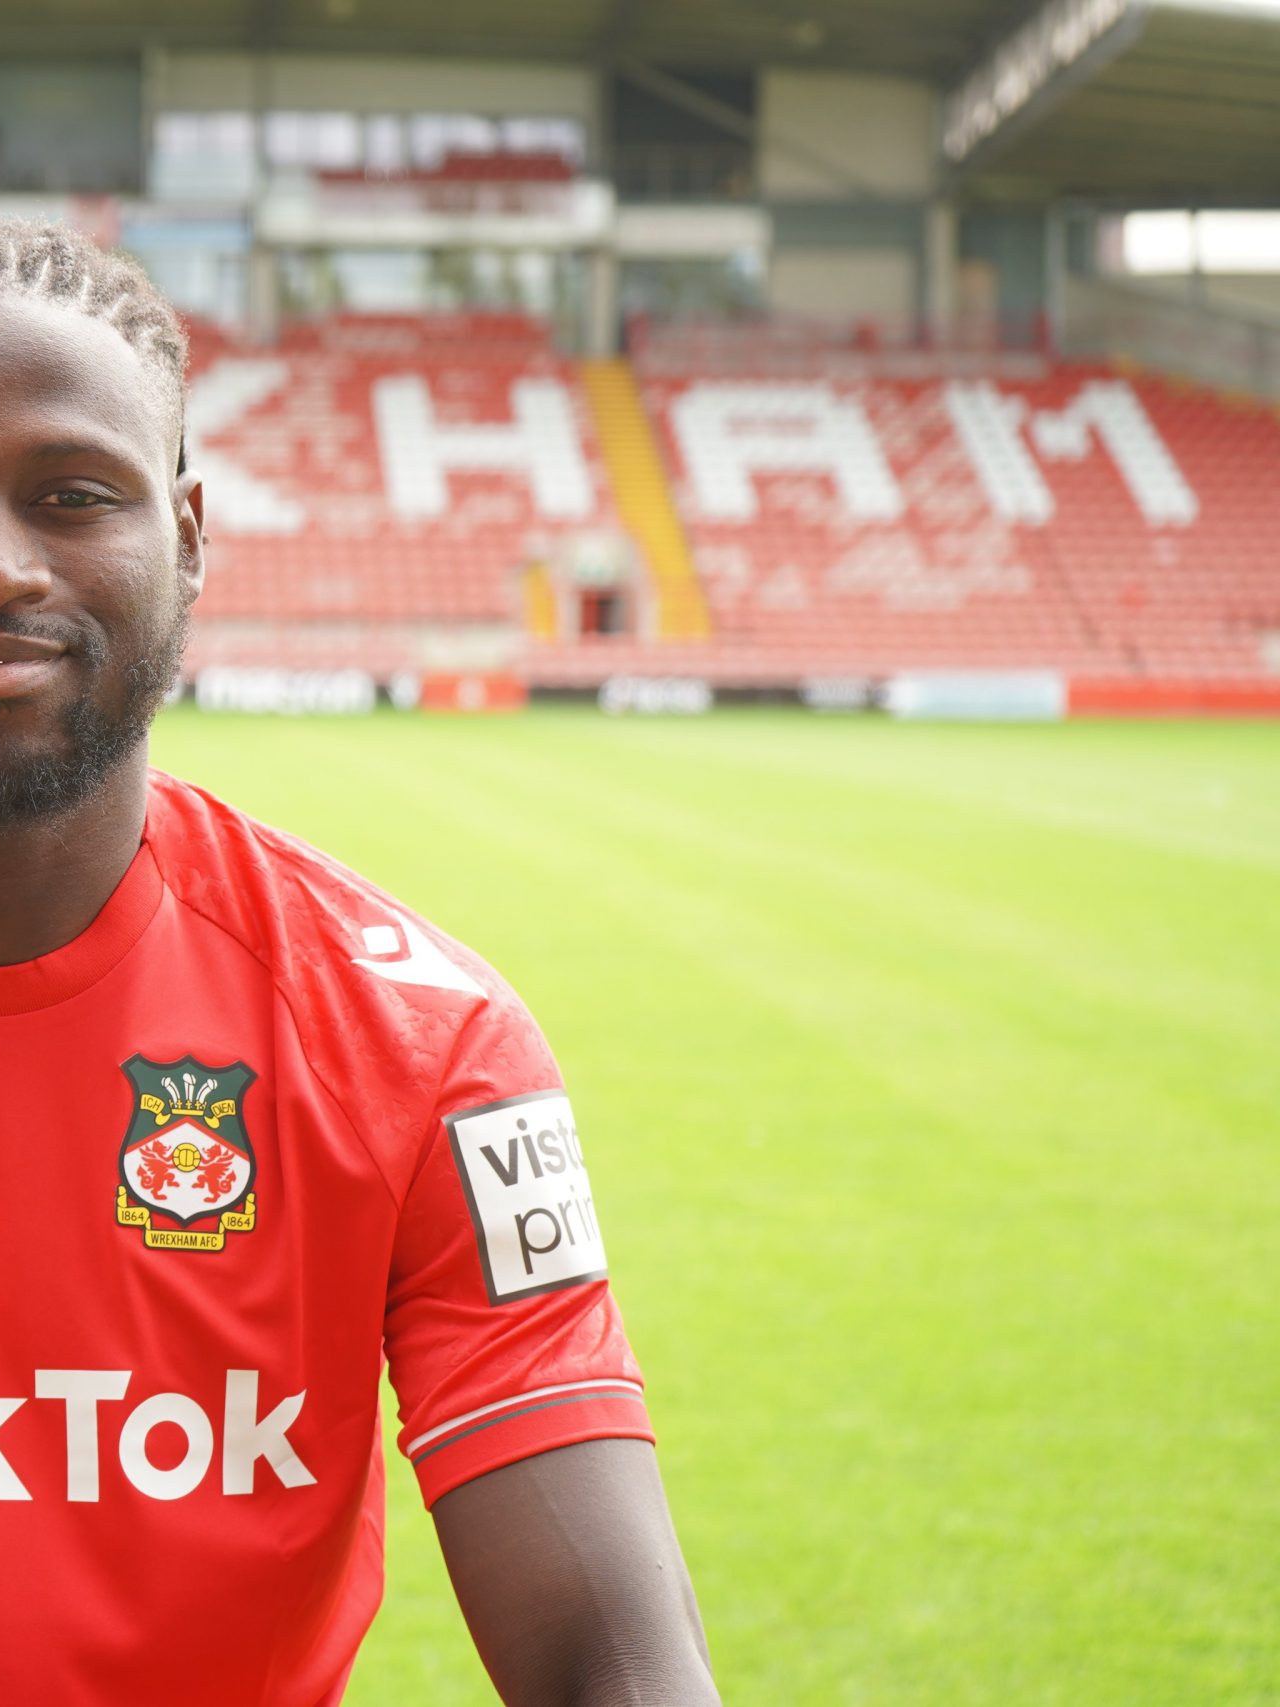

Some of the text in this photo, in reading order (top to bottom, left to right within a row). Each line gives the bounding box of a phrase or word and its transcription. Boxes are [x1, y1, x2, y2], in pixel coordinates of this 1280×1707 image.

[143, 1096, 161, 1111] ICH
[213, 1102, 235, 1116] DIEN
[122, 1208, 145, 1222] 1864
[227, 1215, 250, 1228] 1864
[150, 1233, 218, 1247] WREXHAM AFC
